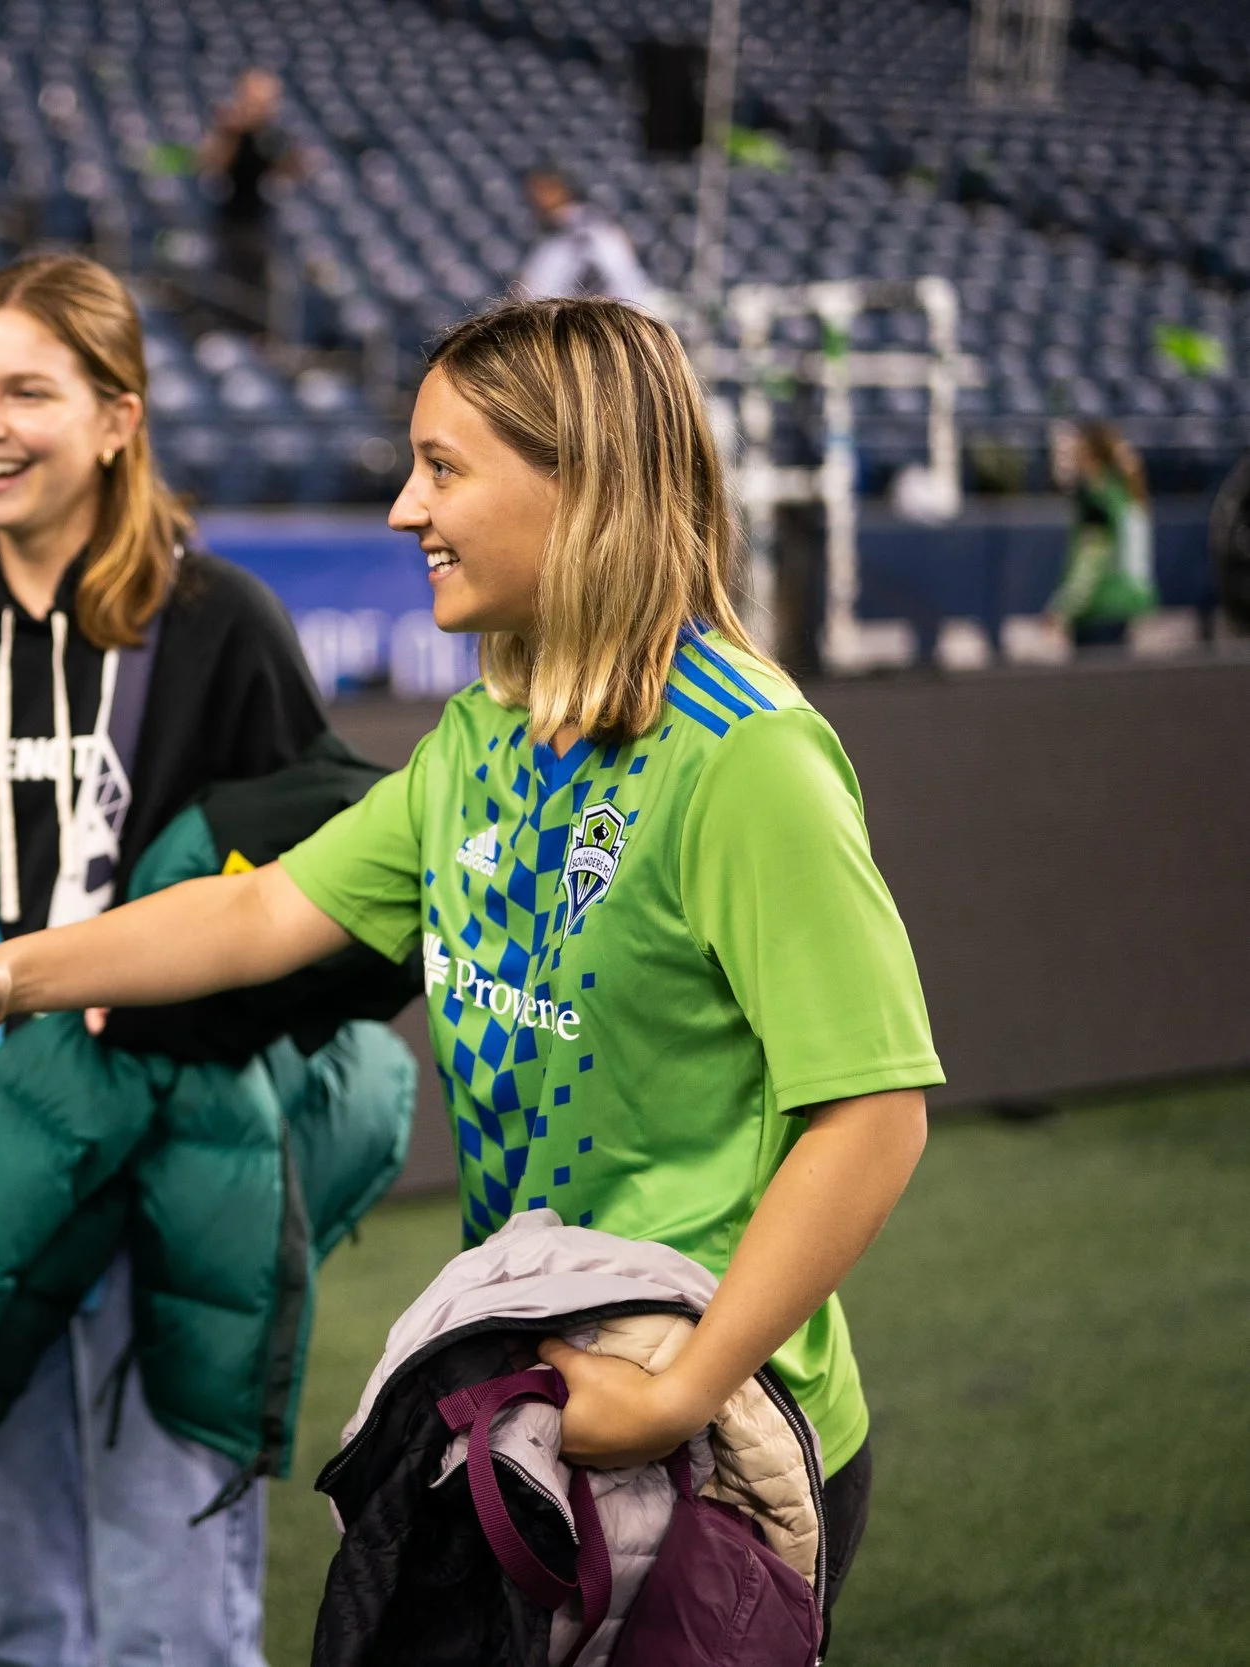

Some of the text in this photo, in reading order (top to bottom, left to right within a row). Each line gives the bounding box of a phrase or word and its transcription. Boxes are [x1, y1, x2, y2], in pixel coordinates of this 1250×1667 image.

[456, 847, 497, 877] adidas
[571, 857, 611, 879] SOUNDERS FC
